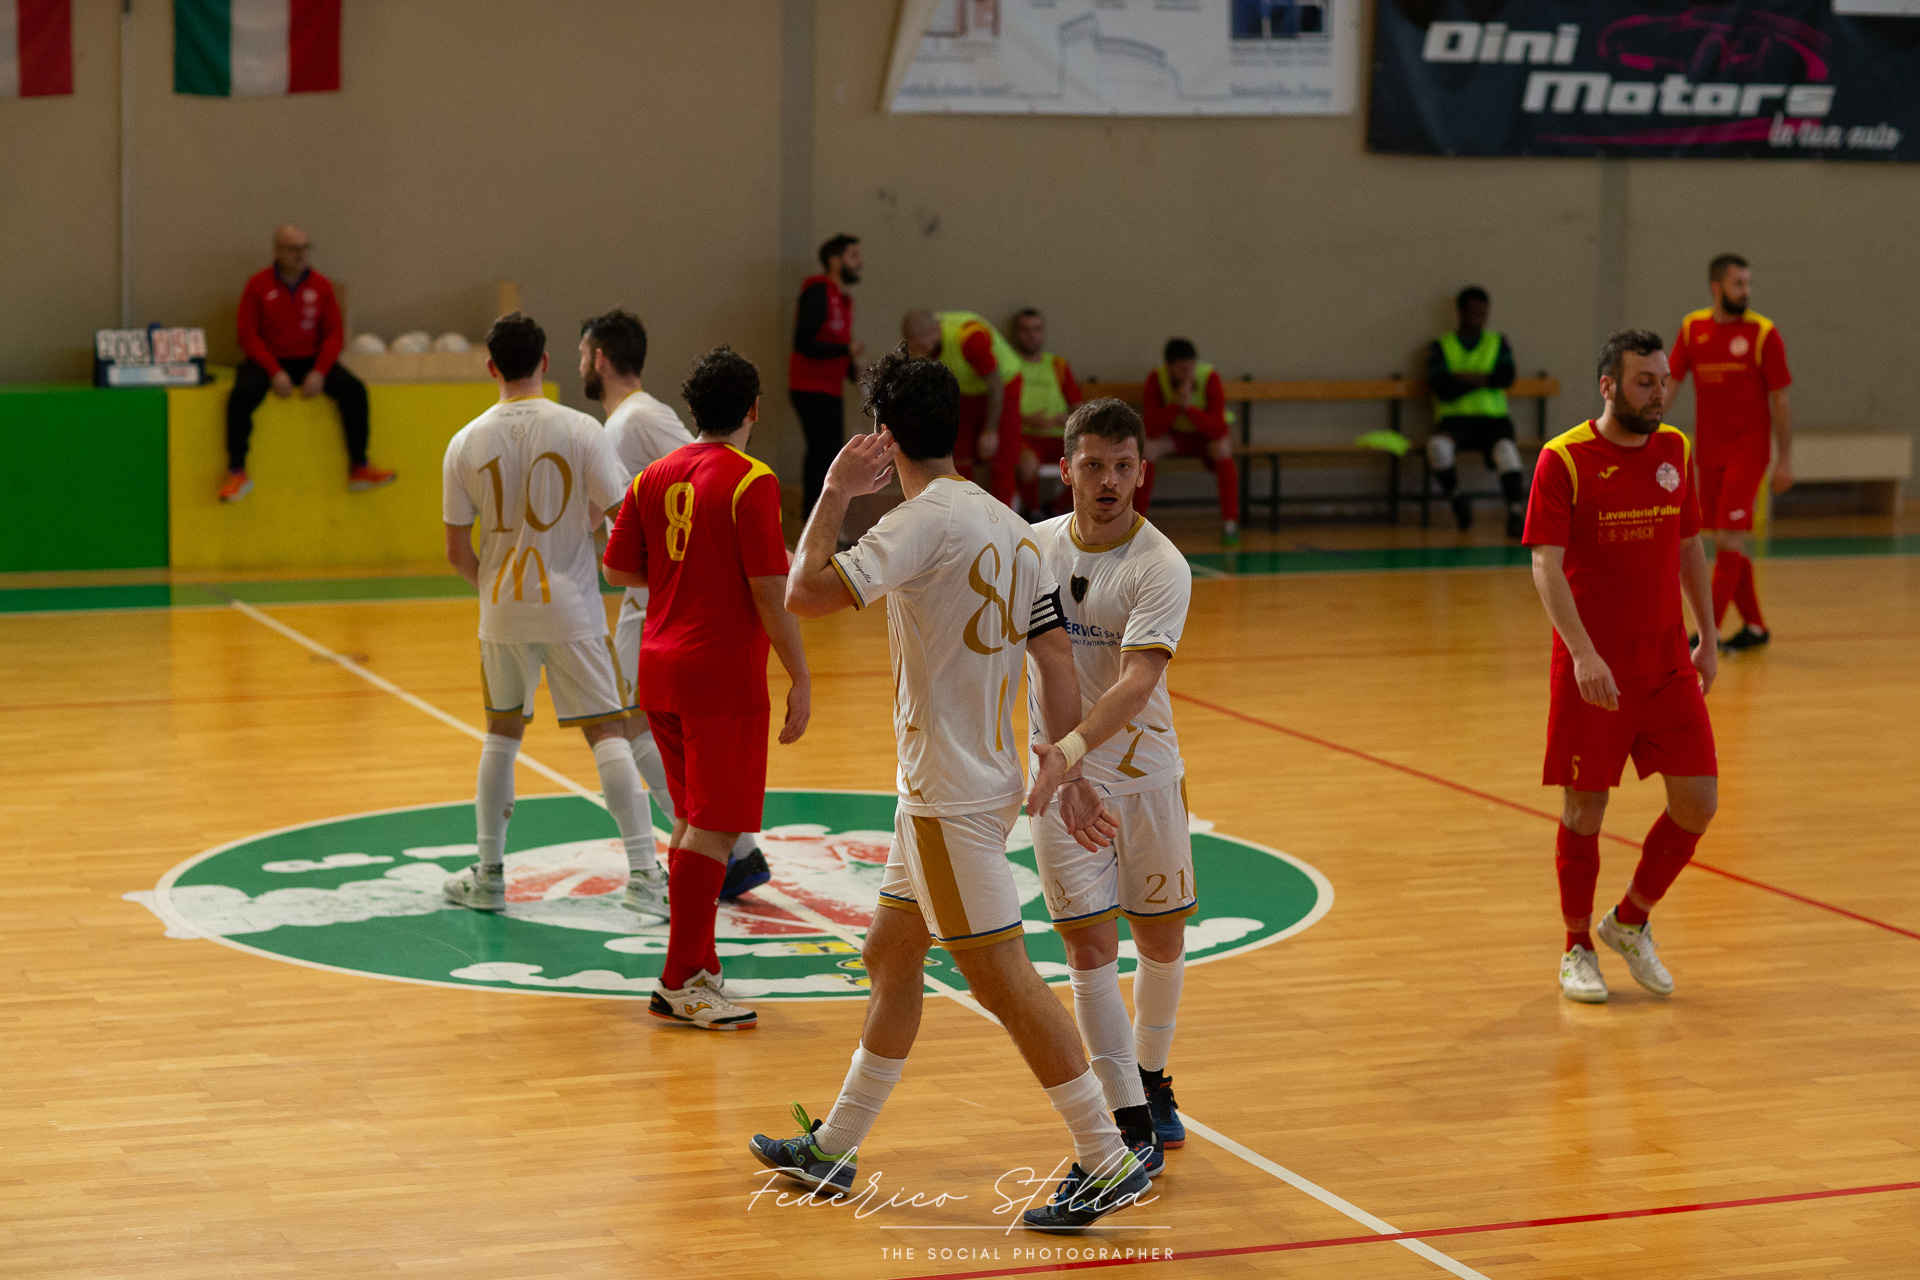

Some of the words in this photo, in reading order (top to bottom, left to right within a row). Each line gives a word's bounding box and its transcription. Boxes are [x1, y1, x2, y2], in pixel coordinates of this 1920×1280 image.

[1522, 71, 1836, 117] Motors
[478, 452, 573, 534] 10
[664, 481, 695, 562] 8
[1064, 621, 1102, 638] ERVICE
[1572, 754, 1581, 780] 5
[1144, 867, 1188, 905] 21
